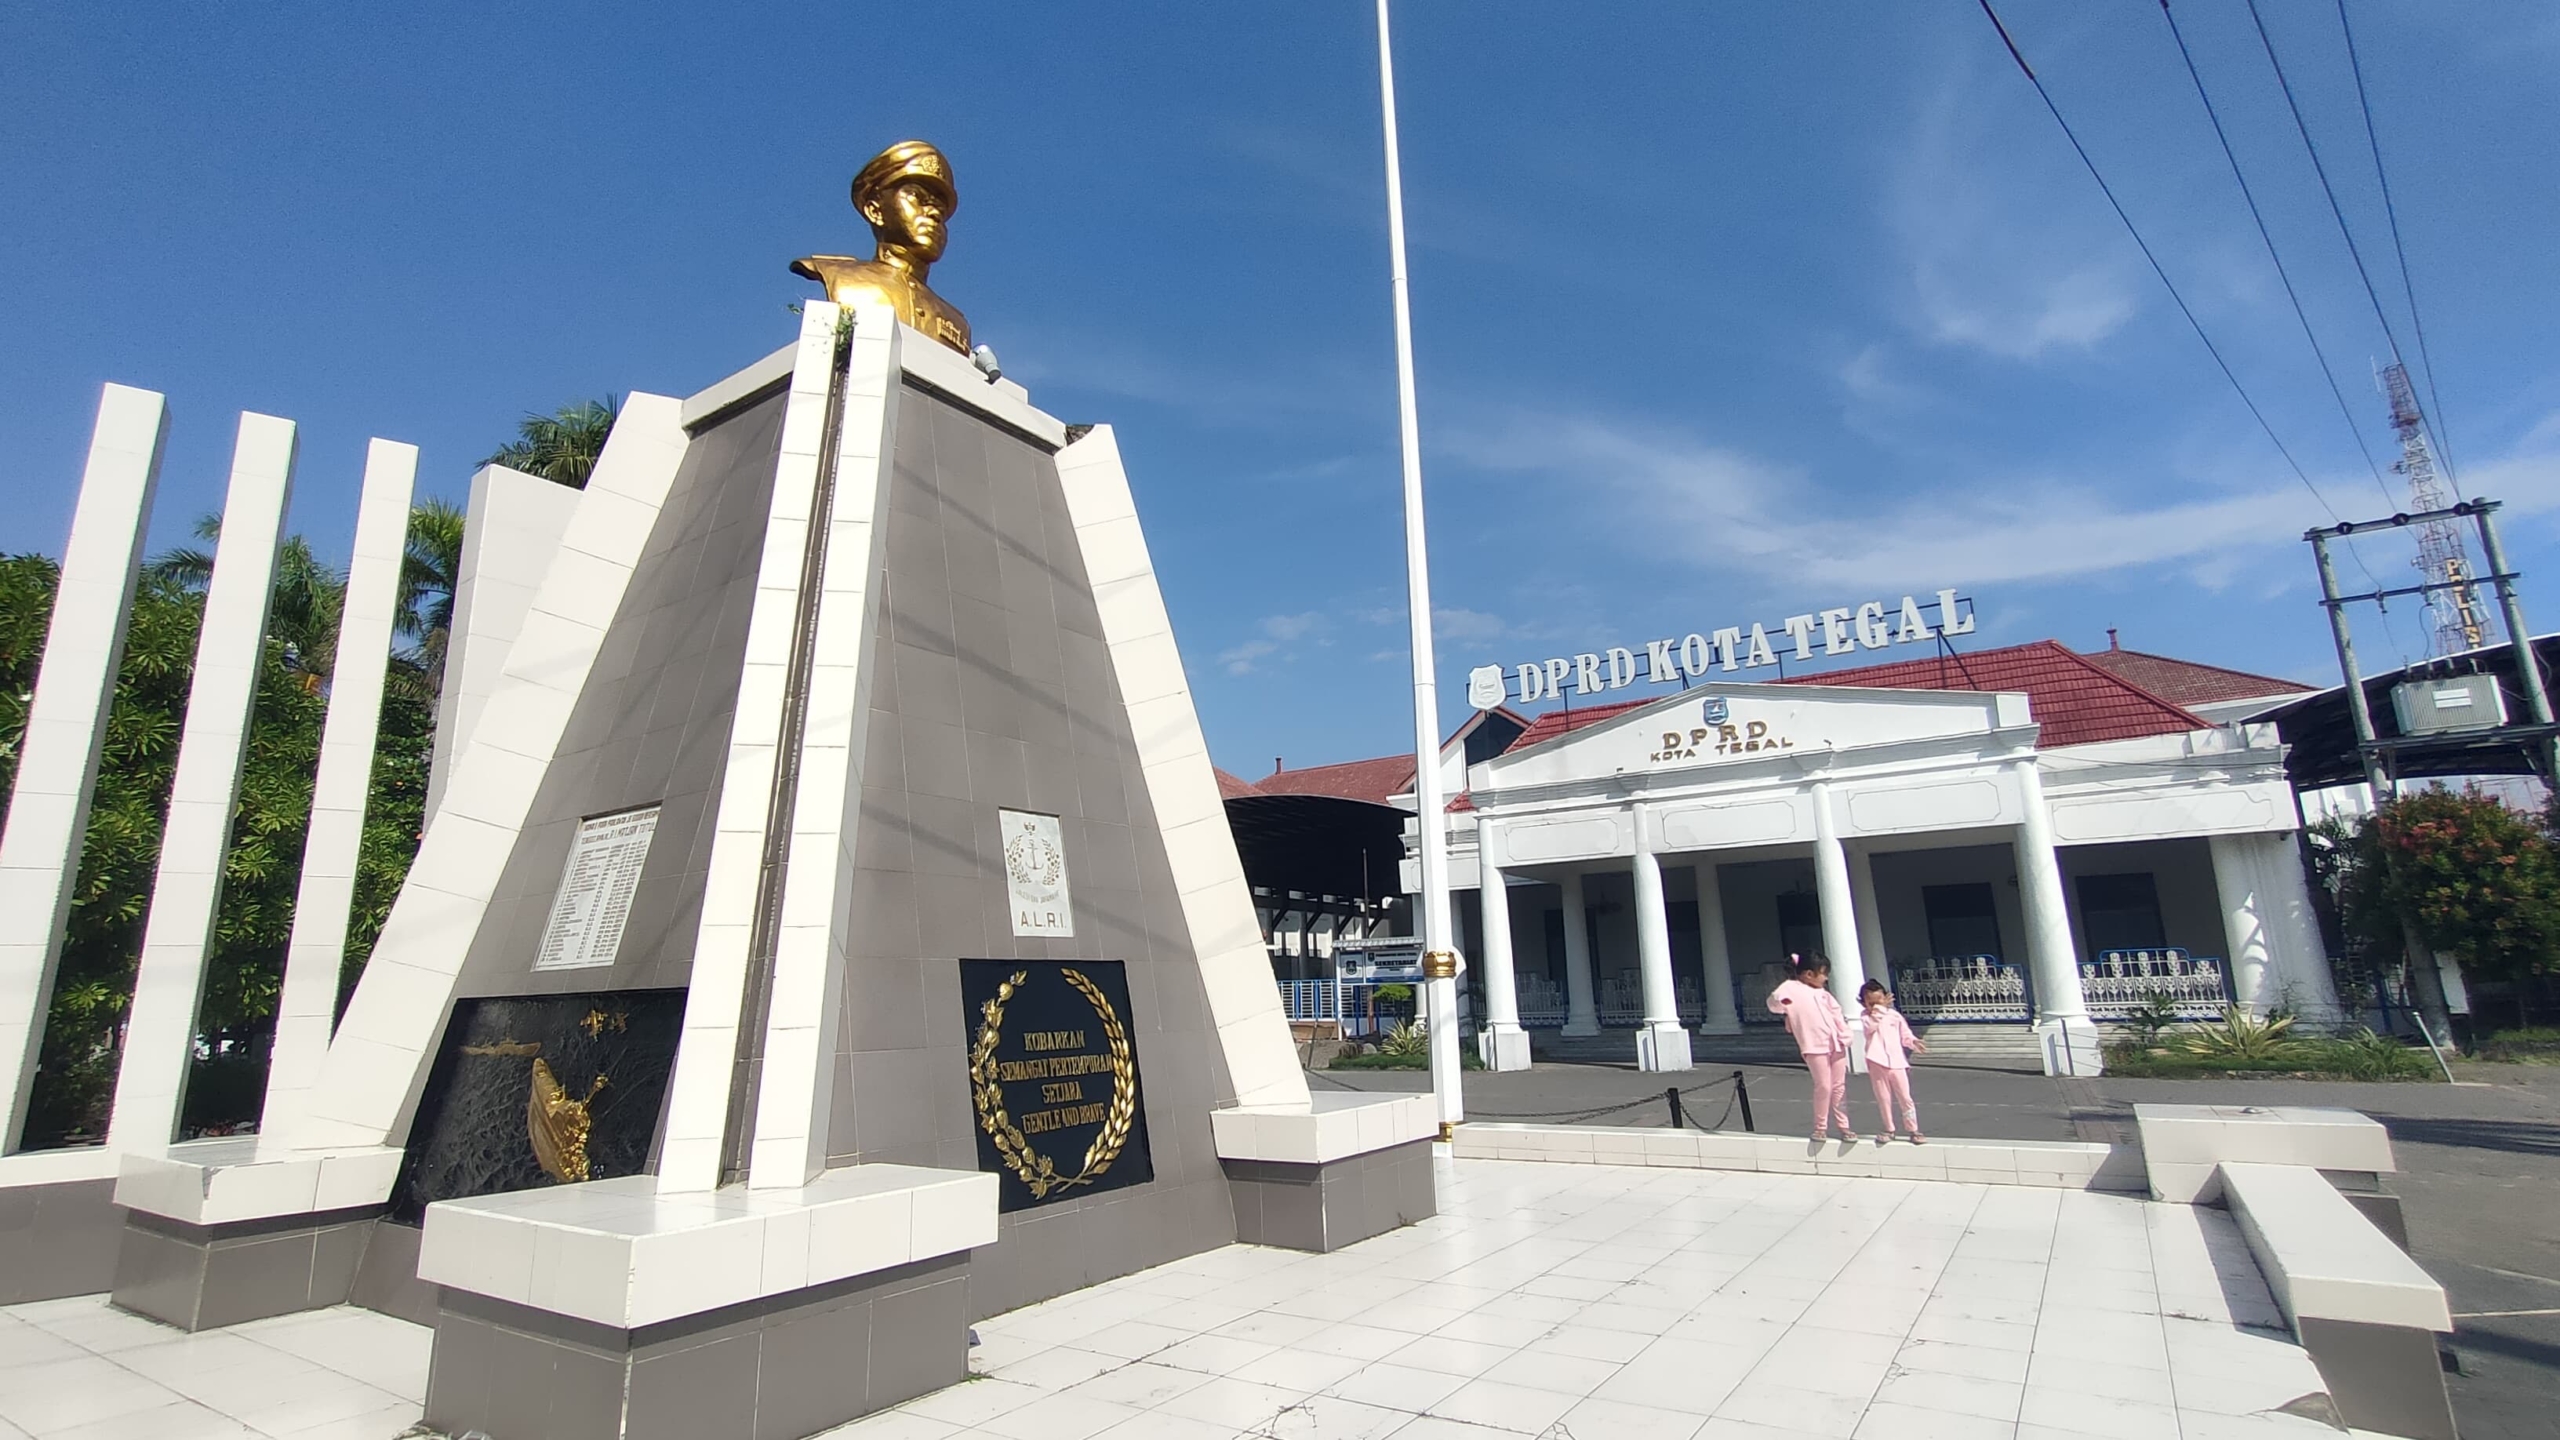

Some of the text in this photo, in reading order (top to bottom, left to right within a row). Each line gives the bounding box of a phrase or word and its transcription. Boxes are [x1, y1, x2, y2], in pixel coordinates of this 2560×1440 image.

[1516, 588, 1975, 703] DPRD KOTA TEGAL
[1650, 736, 1793, 763] KOTA TEGAL
[1662, 720, 1767, 750] DPRD
[1023, 1030, 1086, 1052] KOBARKAN
[1000, 1053, 1113, 1082] SEMANGAT PERTEMPURAN
[1020, 1102, 1106, 1134] GENTLE AND BRAVE
